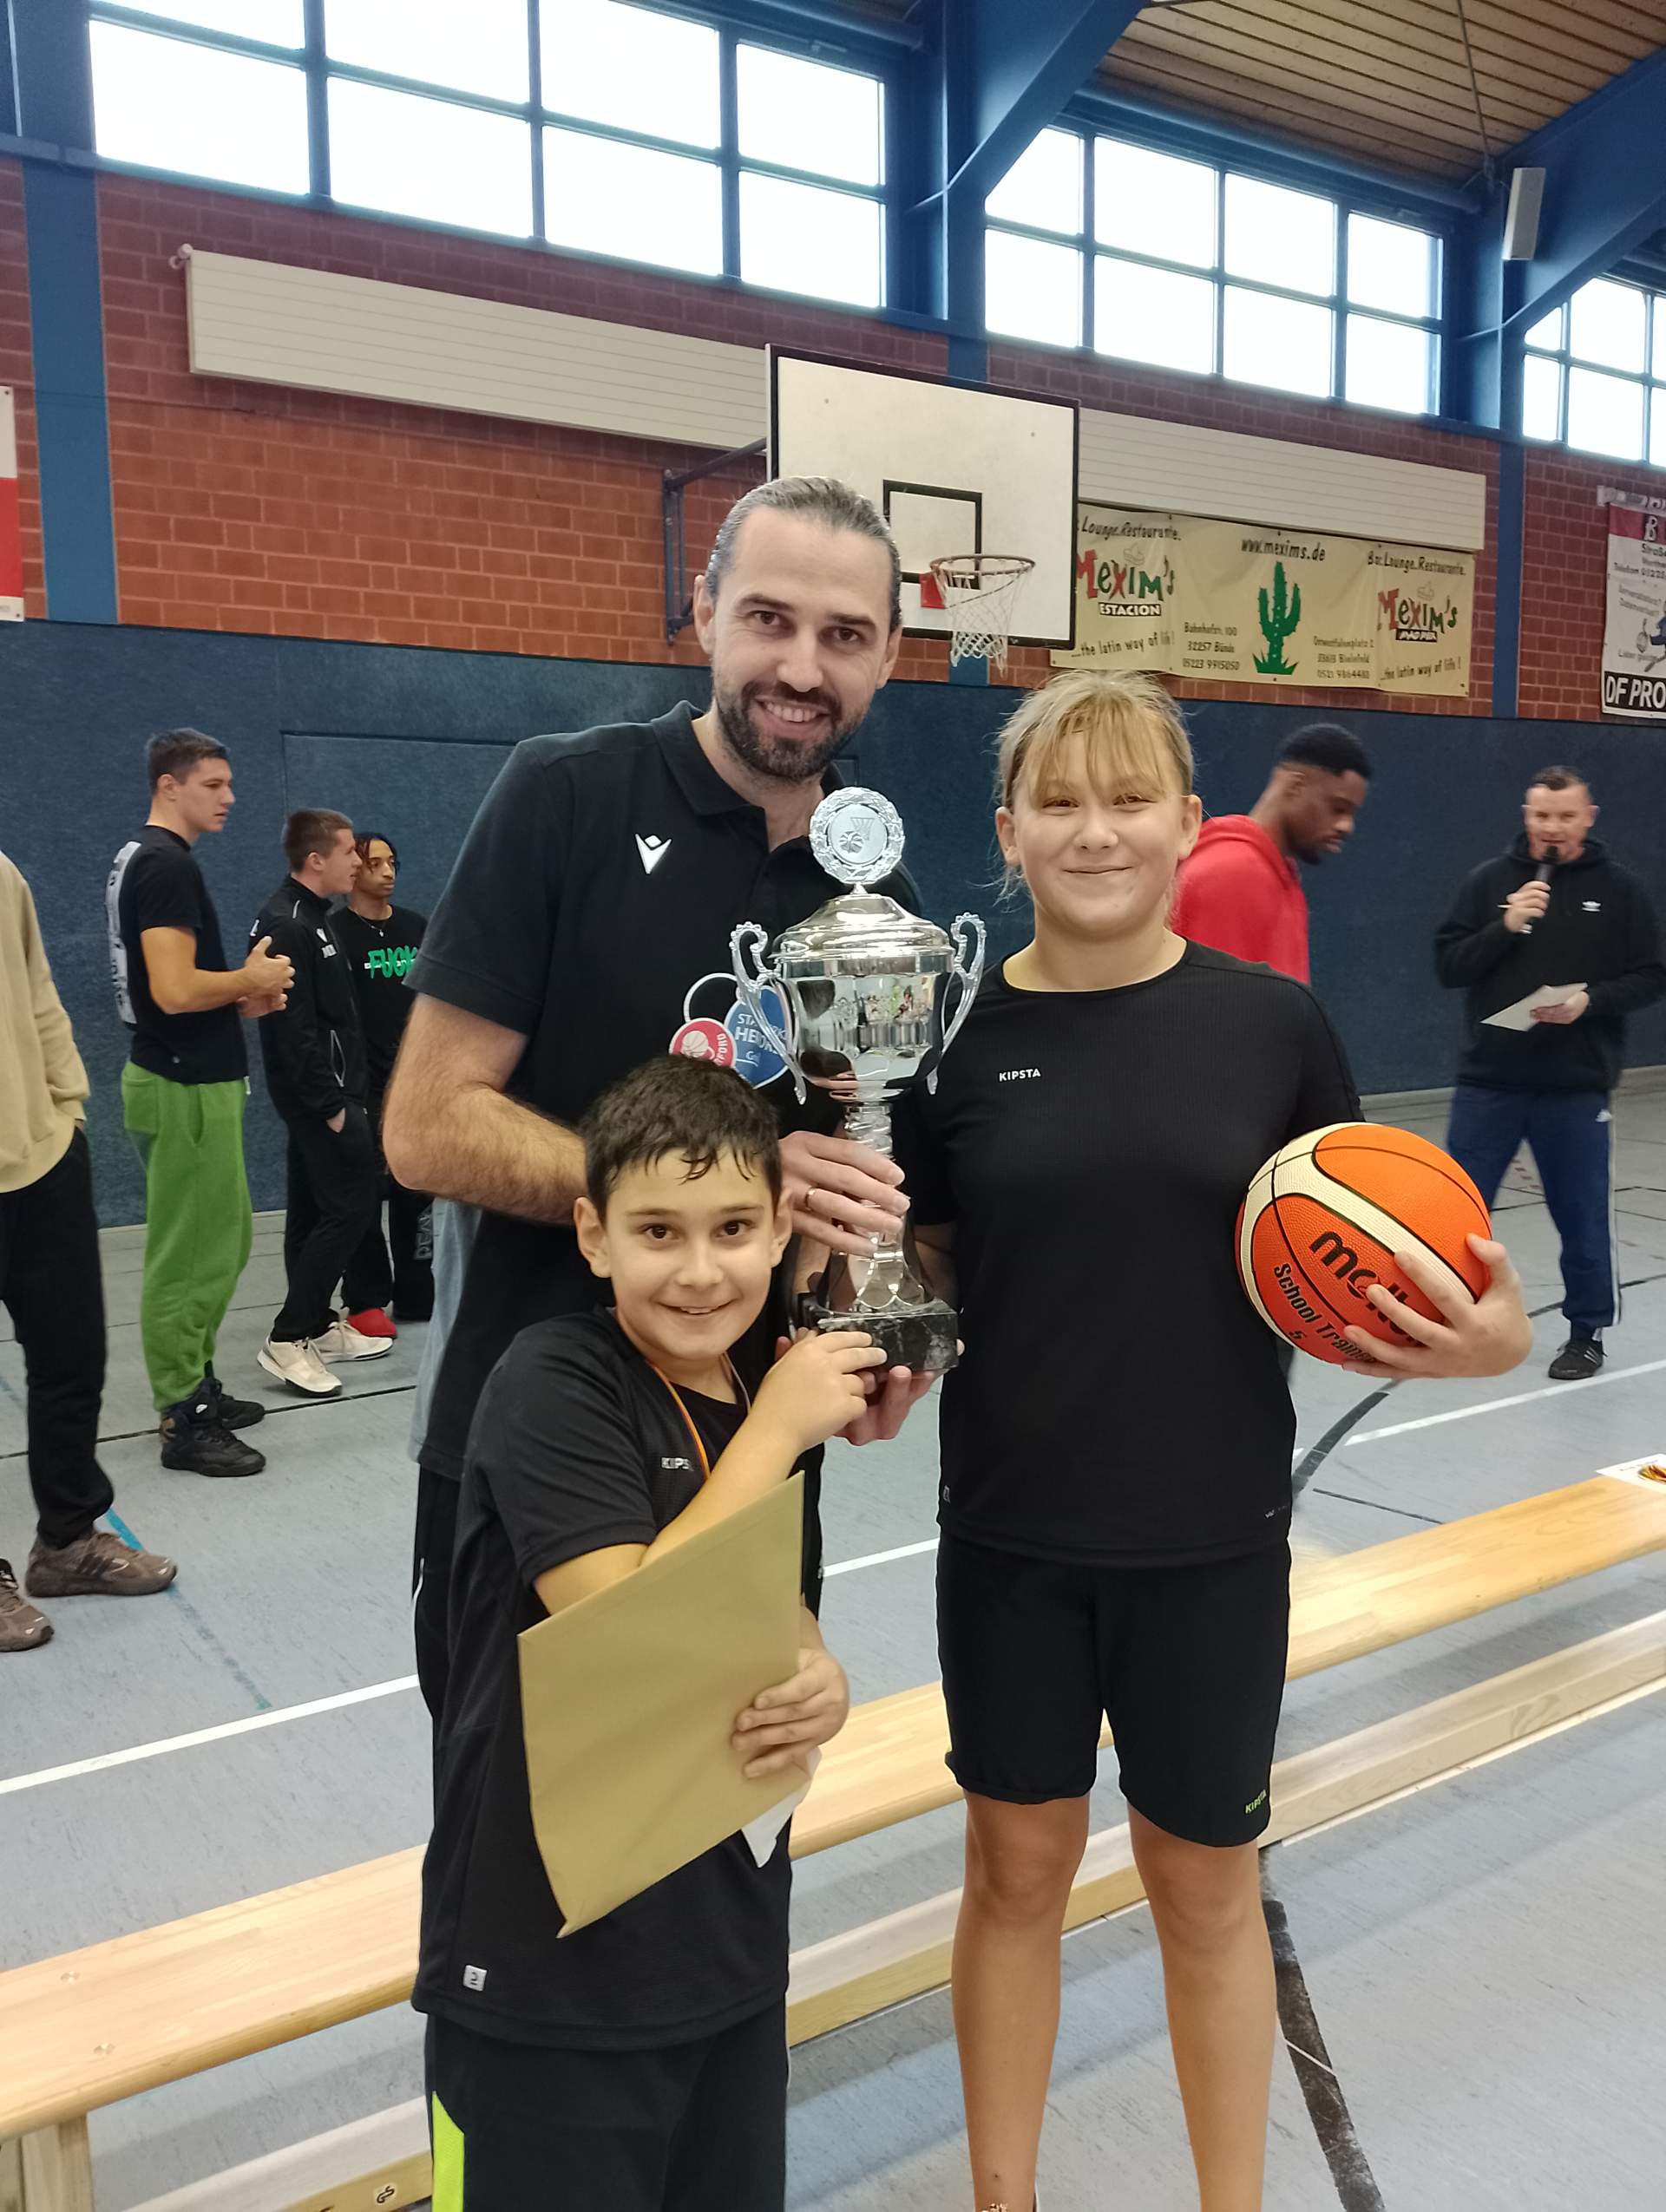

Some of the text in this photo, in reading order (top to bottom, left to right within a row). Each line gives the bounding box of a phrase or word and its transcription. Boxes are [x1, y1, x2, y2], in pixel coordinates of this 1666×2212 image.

[1241, 539, 1326, 561] www.mexims.de
[1099, 604, 1160, 615] ESTACION
[1099, 640, 1122, 654] latin
[1125, 638, 1145, 652] way
[1148, 632, 1158, 646] of
[999, 1068, 1041, 1082] KIPSTA
[1273, 1262, 1323, 1324] School
